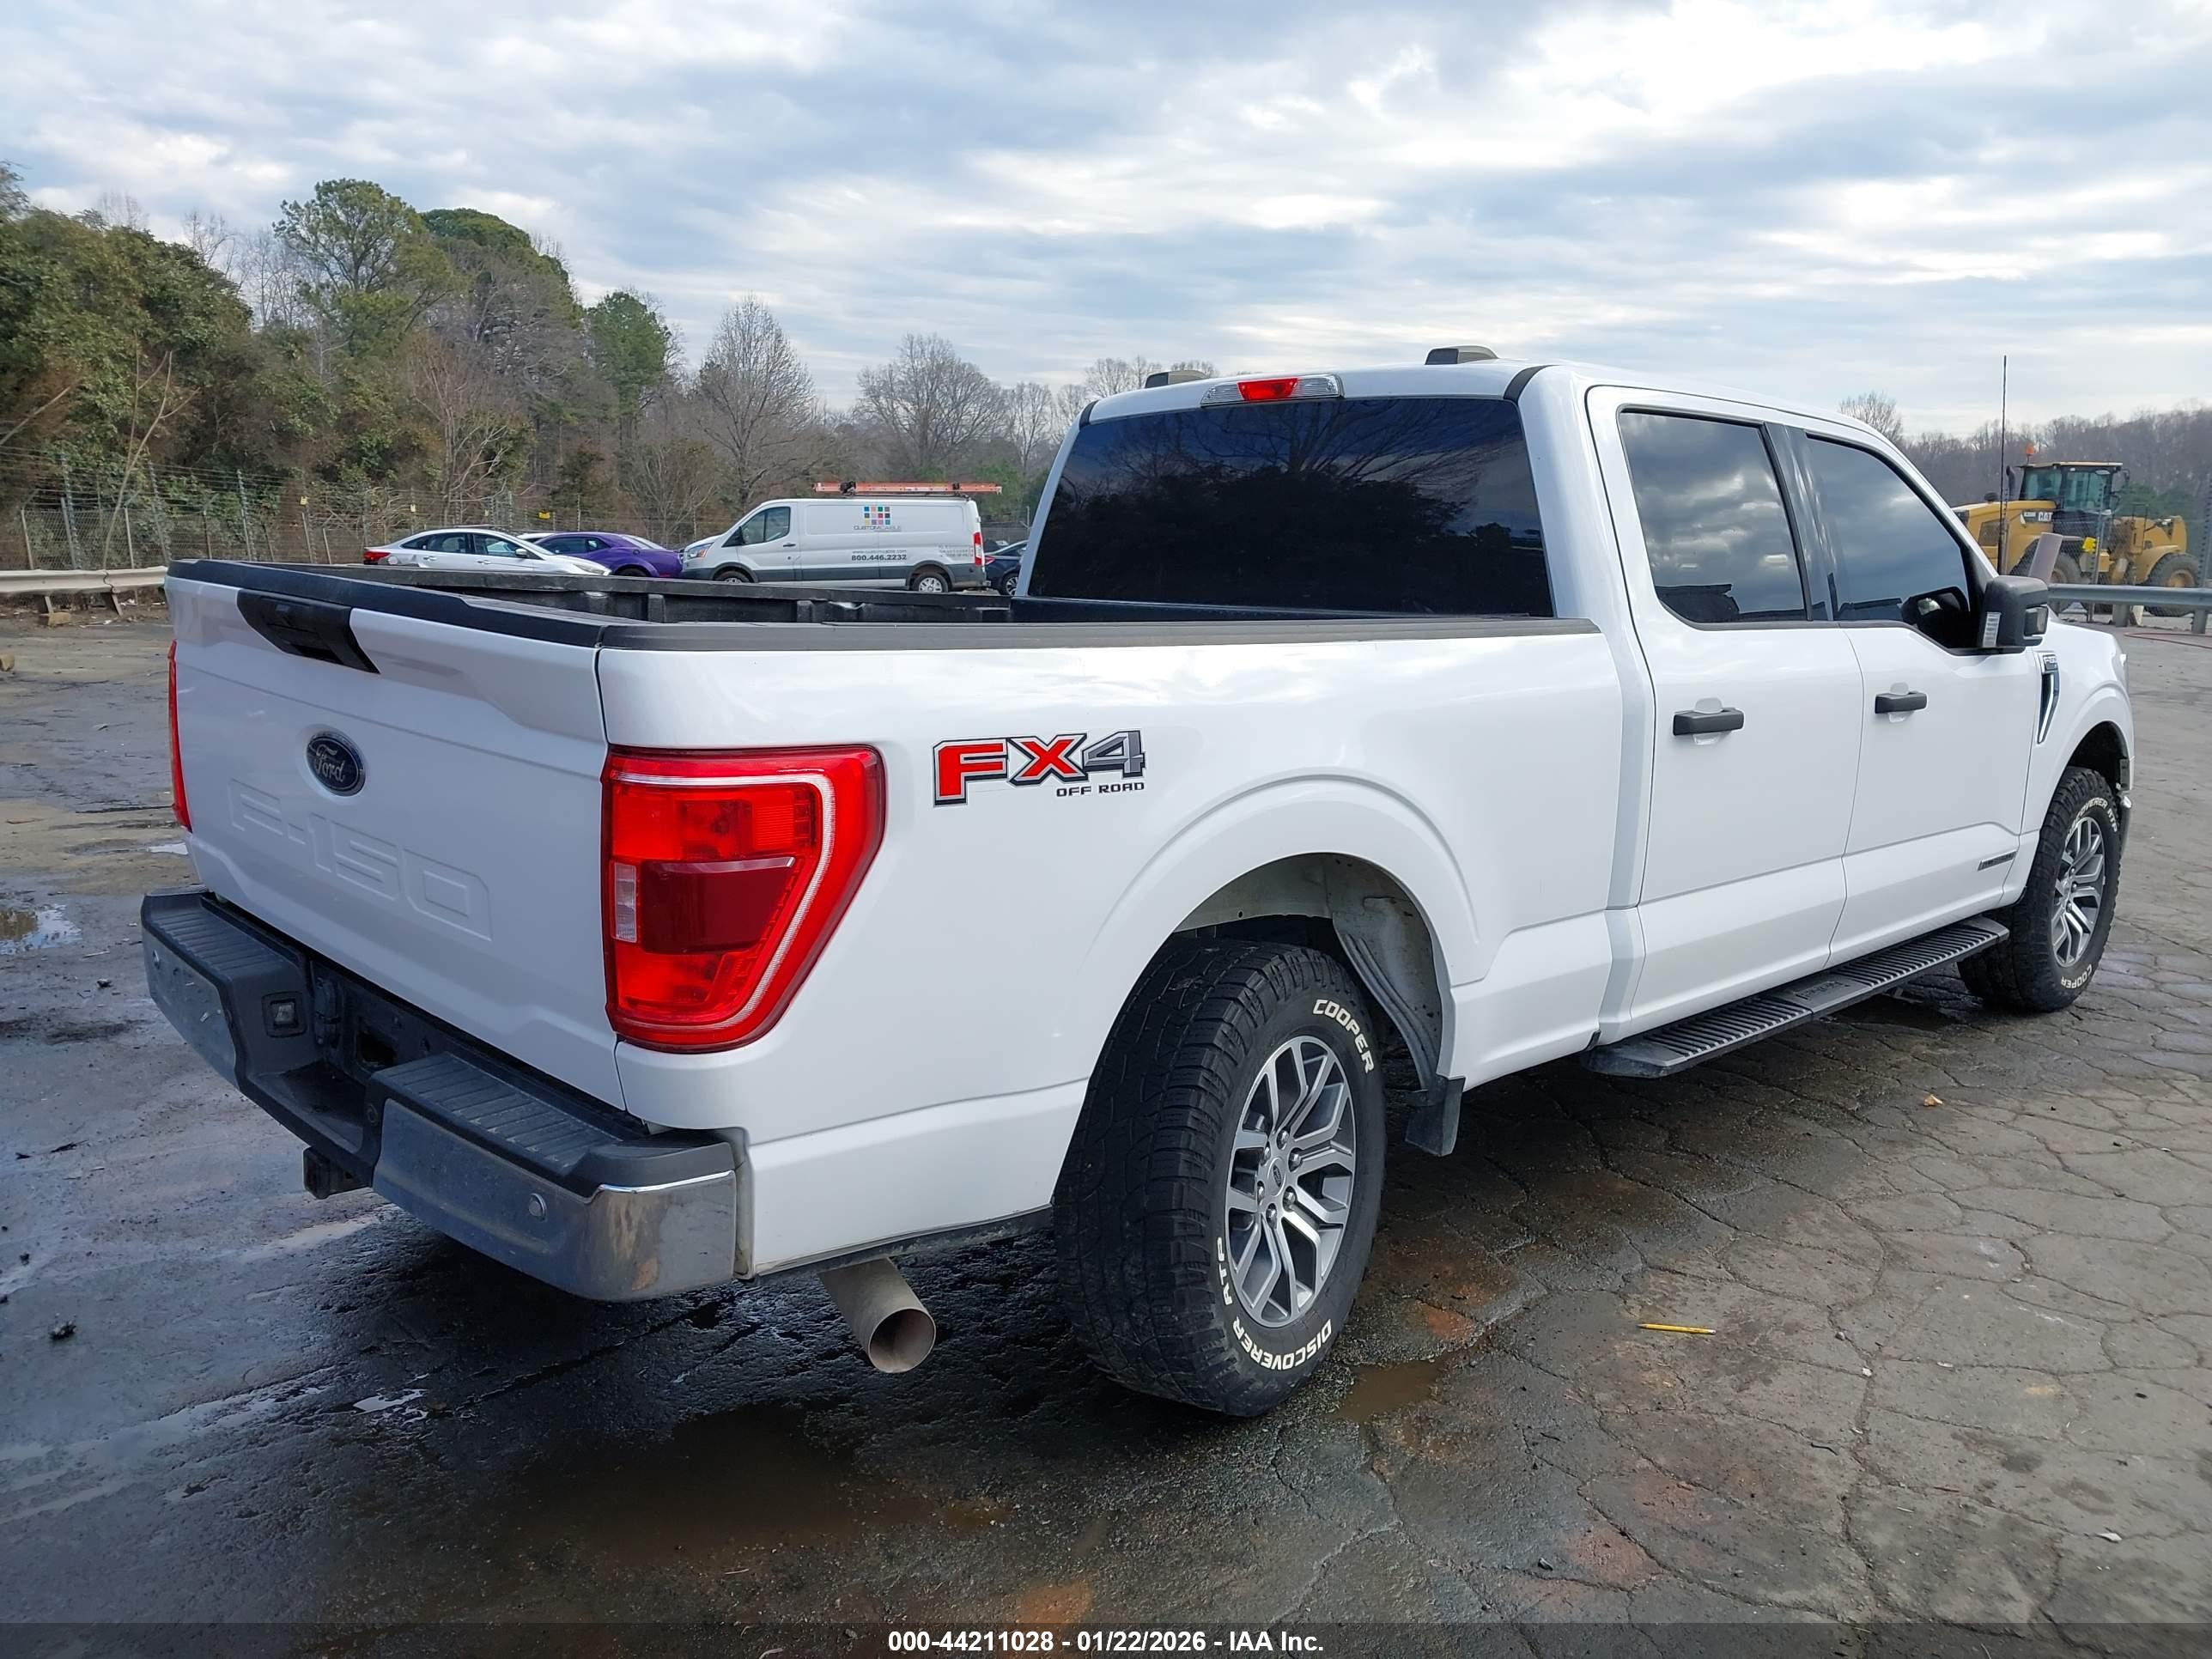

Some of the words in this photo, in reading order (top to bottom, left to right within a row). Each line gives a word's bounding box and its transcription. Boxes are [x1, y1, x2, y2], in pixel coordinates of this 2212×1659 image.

[2039, 512, 2053, 521] CAT
[310, 743, 346, 783] Ford
[933, 730, 1146, 806] FX4
[1056, 786, 1091, 798] OFF
[1098, 781, 1145, 794] ROAD
[228, 778, 494, 942] F-150
[2061, 963, 2093, 988] COOPER
[1313, 999, 1375, 1073] COOPER
[1232, 1315, 1332, 1370] DISCOVERER
